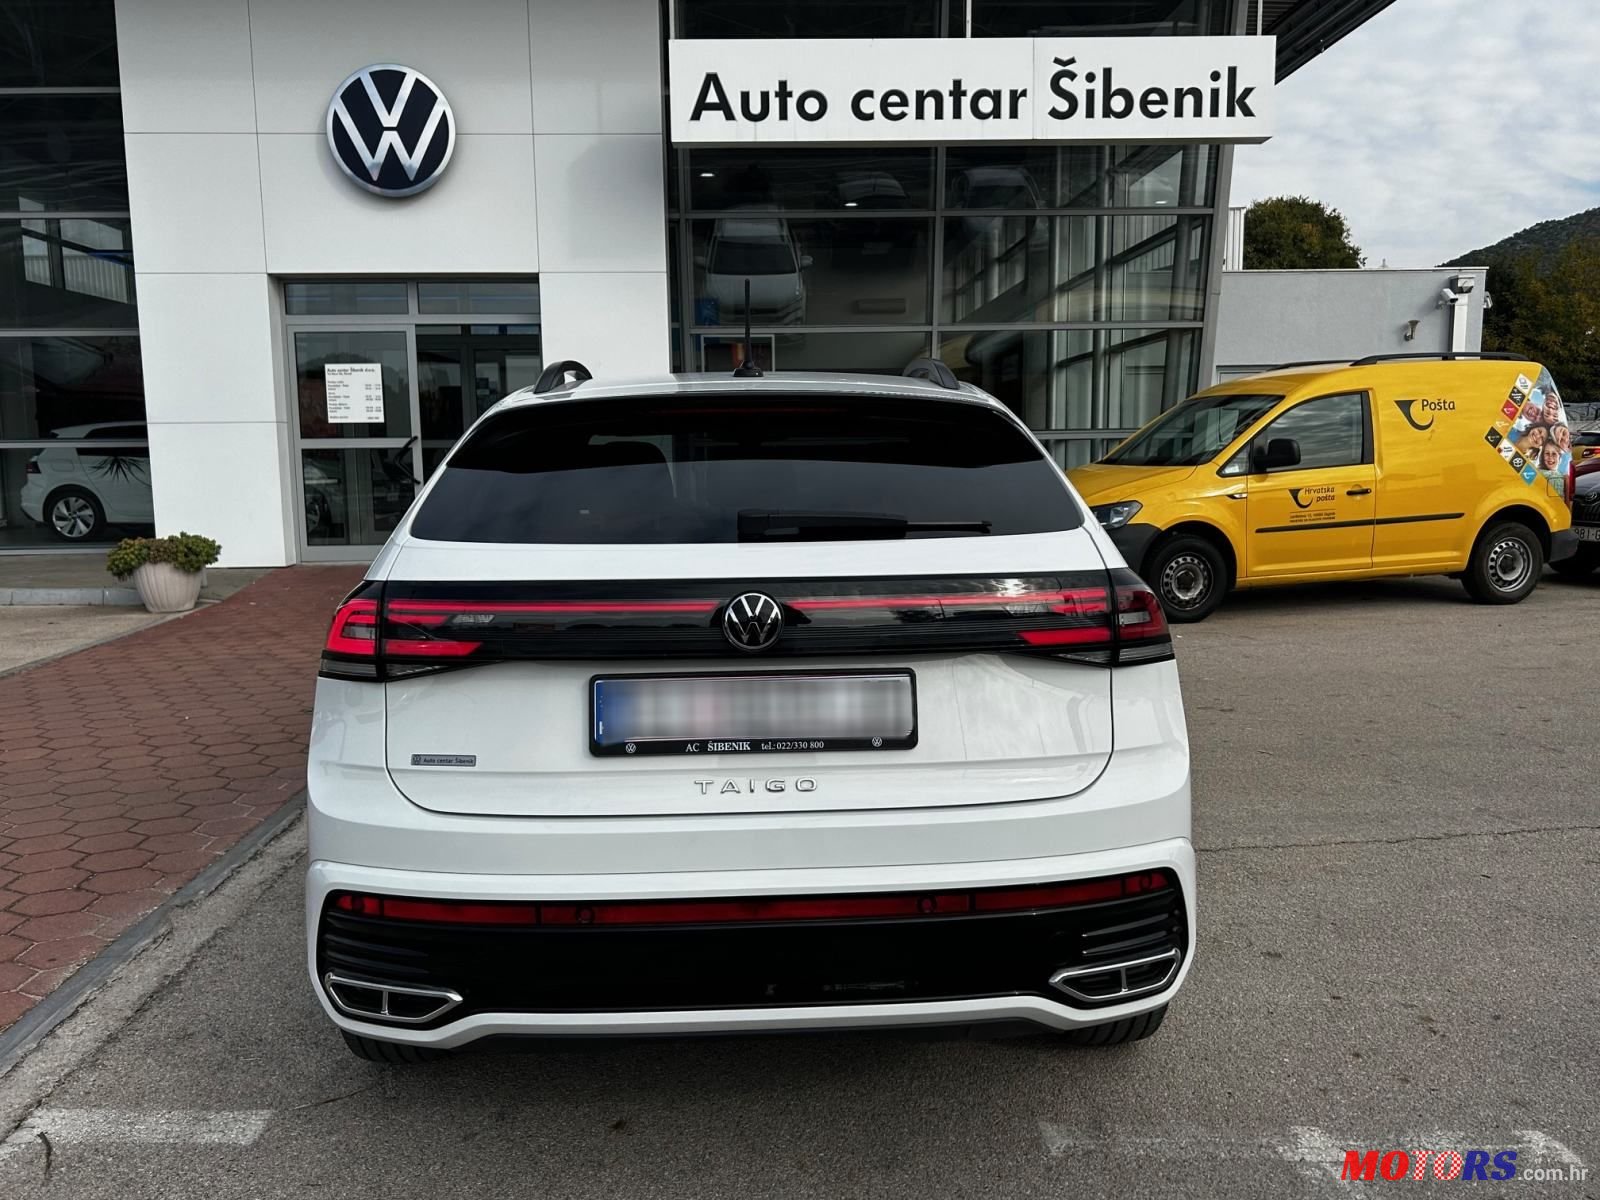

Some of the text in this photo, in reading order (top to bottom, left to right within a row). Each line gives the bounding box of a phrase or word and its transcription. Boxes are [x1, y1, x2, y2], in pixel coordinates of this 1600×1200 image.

[690, 56, 1257, 122] Auto centar Šibenik
[1421, 398, 1456, 412] Pošta
[1305, 487, 1335, 495] Hrvatska
[1316, 495, 1335, 503] pošta
[685, 743, 700, 752] AC
[707, 740, 751, 752] ŠIBENIK
[809, 740, 825, 750] 800
[694, 777, 818, 795] TAIGO
